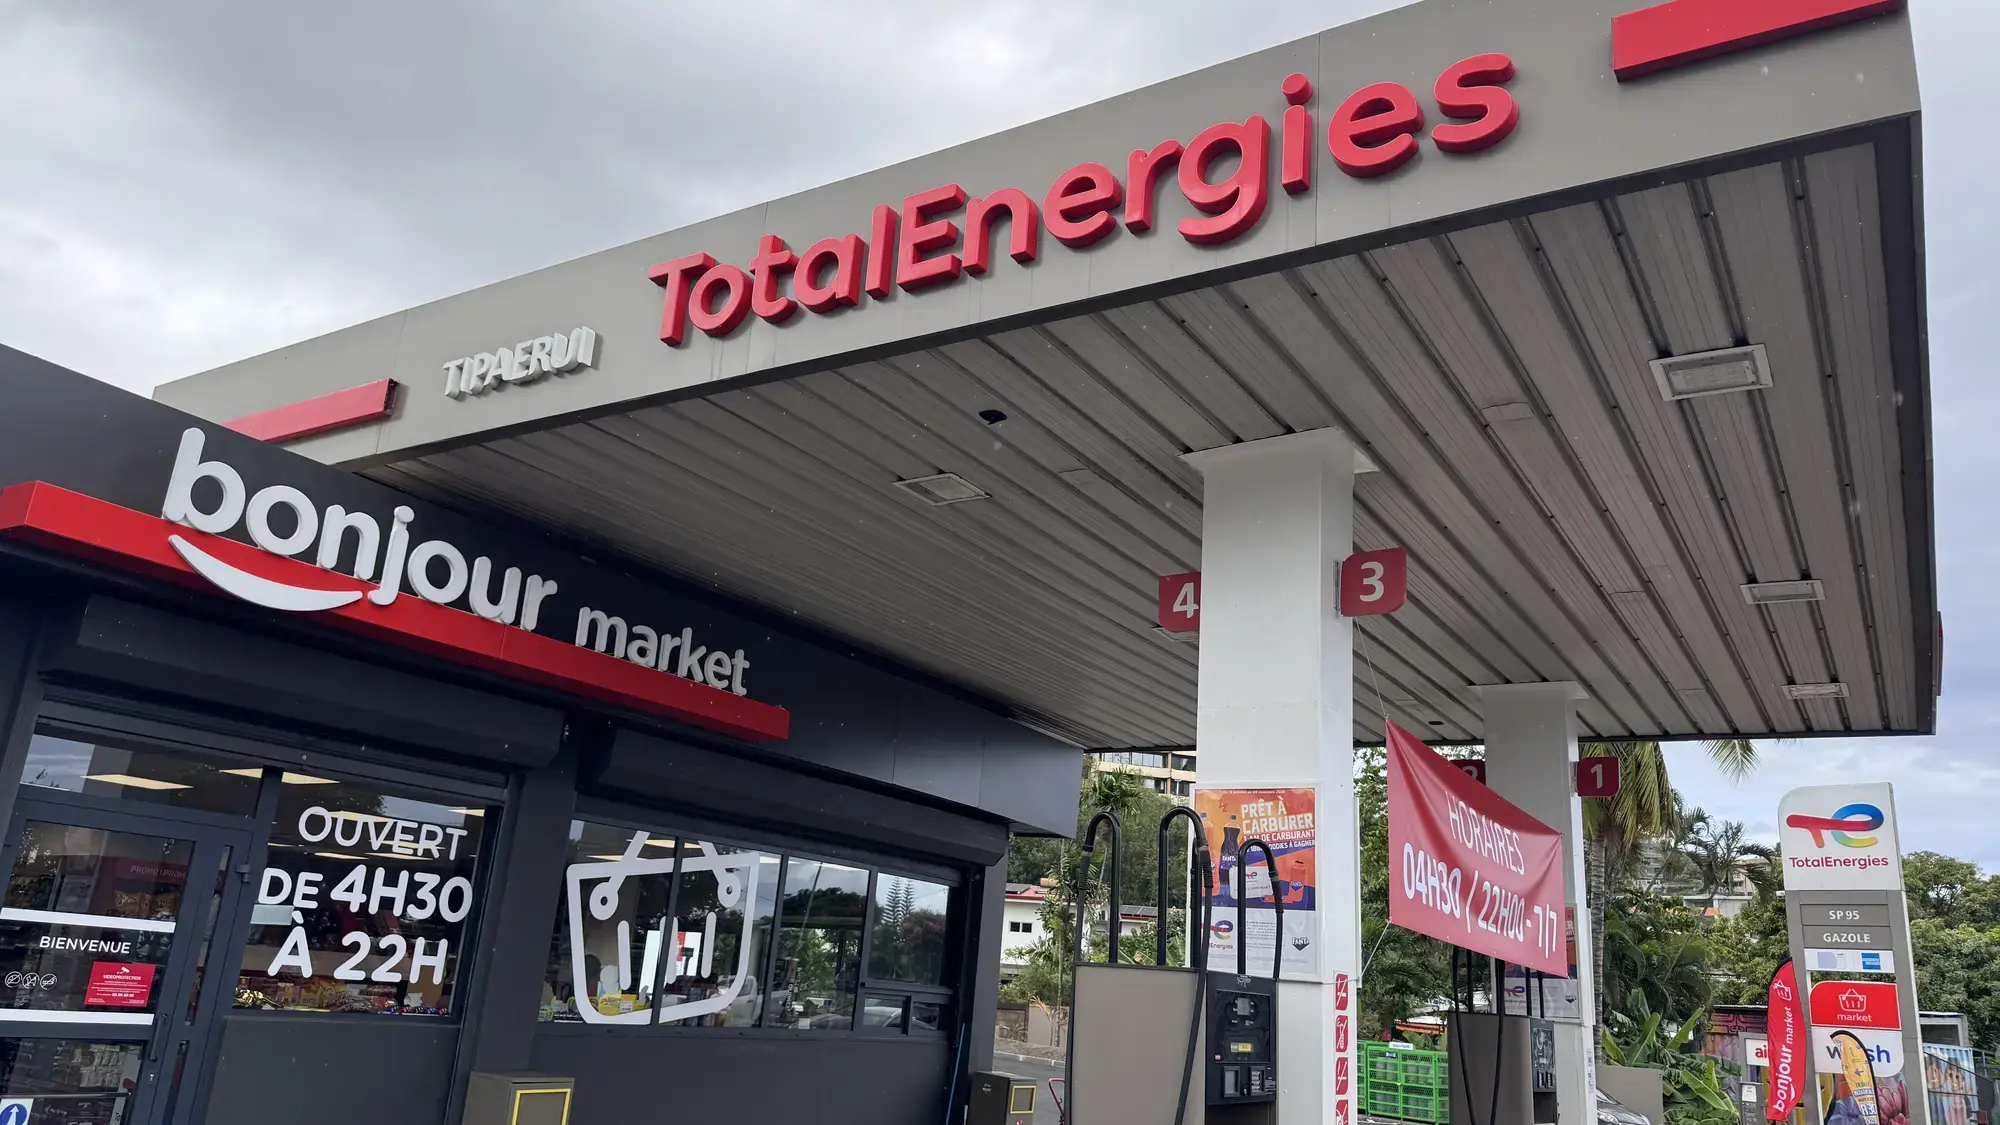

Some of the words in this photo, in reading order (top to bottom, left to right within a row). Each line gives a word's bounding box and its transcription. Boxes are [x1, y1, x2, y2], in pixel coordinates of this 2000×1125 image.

[648, 51, 1519, 348] TotalEnergies
[443, 325, 596, 399] TIPAERUI
[161, 427, 558, 631] bonjour
[575, 606, 751, 696] market
[1359, 561, 1385, 602] 3
[1172, 582, 1199, 619] 4
[1590, 763, 1603, 789] 1
[1241, 799, 1274, 819] PRÊT
[1278, 795, 1287, 815] À
[298, 805, 468, 861] OUVERT
[1242, 813, 1314, 835] CARBURER
[1261, 833, 1271, 842] DE
[1271, 829, 1315, 840] CARBURANT
[1445, 790, 1525, 876] HORAIRES
[1788, 854, 1889, 870] TotalEnergies
[258, 867, 324, 909] DE
[330, 864, 473, 923] 4H30
[1403, 842, 1462, 919] 04H30
[1829, 910, 1843, 919] SP
[1845, 911, 1860, 920] 95
[39, 935, 131, 954] BIENVENUE
[267, 910, 313, 979] À
[333, 931, 449, 985] 22H
[1823, 933, 1871, 943] GAZOLE
[1837, 1013, 1872, 1022] market
[1755, 1044, 1768, 1059] ai
[1773, 1045, 1793, 1113] bonjour
[1784, 1007, 1794, 1045] market
[1826, 1044, 1891, 1064] wsh
